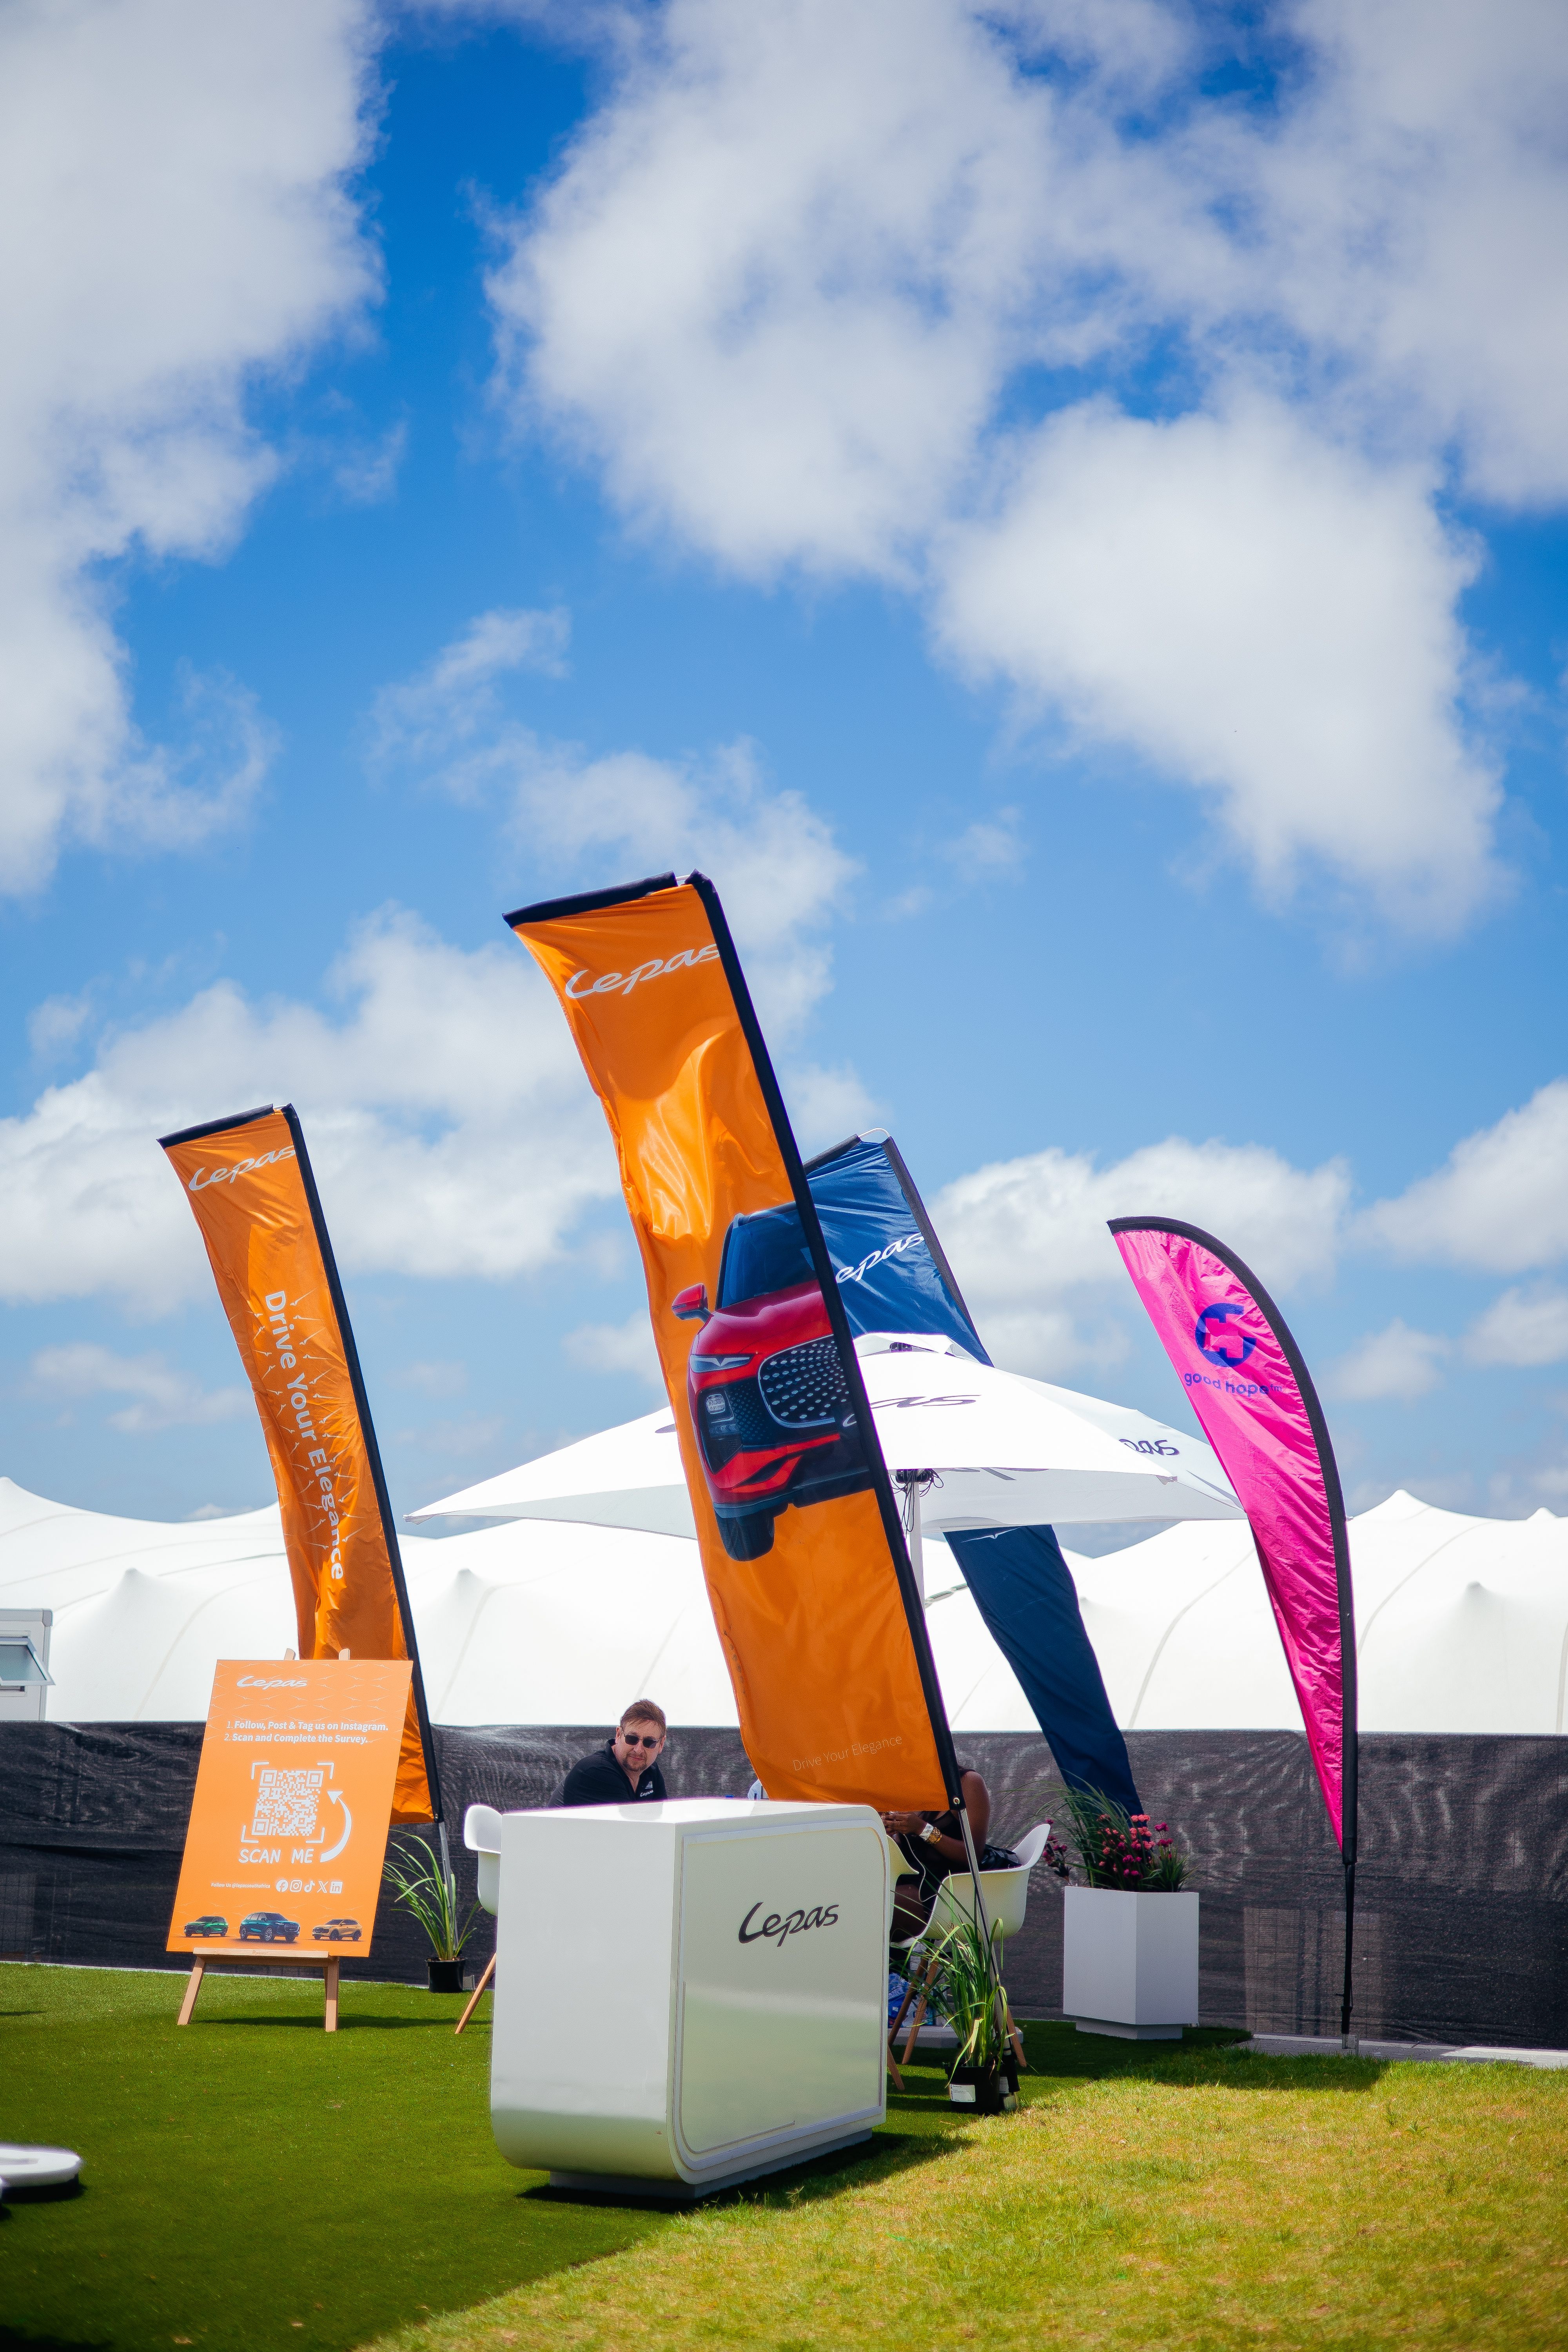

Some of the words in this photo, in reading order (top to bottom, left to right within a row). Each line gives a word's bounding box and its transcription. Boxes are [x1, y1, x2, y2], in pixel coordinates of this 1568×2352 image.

[565, 943, 721, 999] Lepas
[189, 1145, 296, 1191] Lepas
[836, 1232, 924, 1283] epas
[1184, 1373, 1222, 1389] good
[265, 1290, 297, 1369] Drive
[287, 1372, 317, 1441] Your
[308, 1448, 344, 1580] Elegance
[237, 1675, 308, 1690] Lepas
[232, 1733, 253, 1742] Scan
[255, 1733, 273, 1742] and
[274, 1733, 316, 1744] Complete
[318, 1734, 333, 1742] the
[335, 1734, 368, 1745] Survey.
[234, 1720, 266, 1731] Follow,
[268, 1721, 287, 1730] Post
[289, 1721, 296, 1730] &
[298, 1722, 314, 1731] Tag
[340, 1722, 388, 1732] Instagram.
[793, 1757, 822, 1771] Drive
[823, 1748, 849, 1763] Your
[851, 1736, 902, 1756] Elegance
[238, 1849, 281, 1864] SCAN
[291, 1849, 314, 1864] ME
[738, 1901, 839, 1947] Lepas
